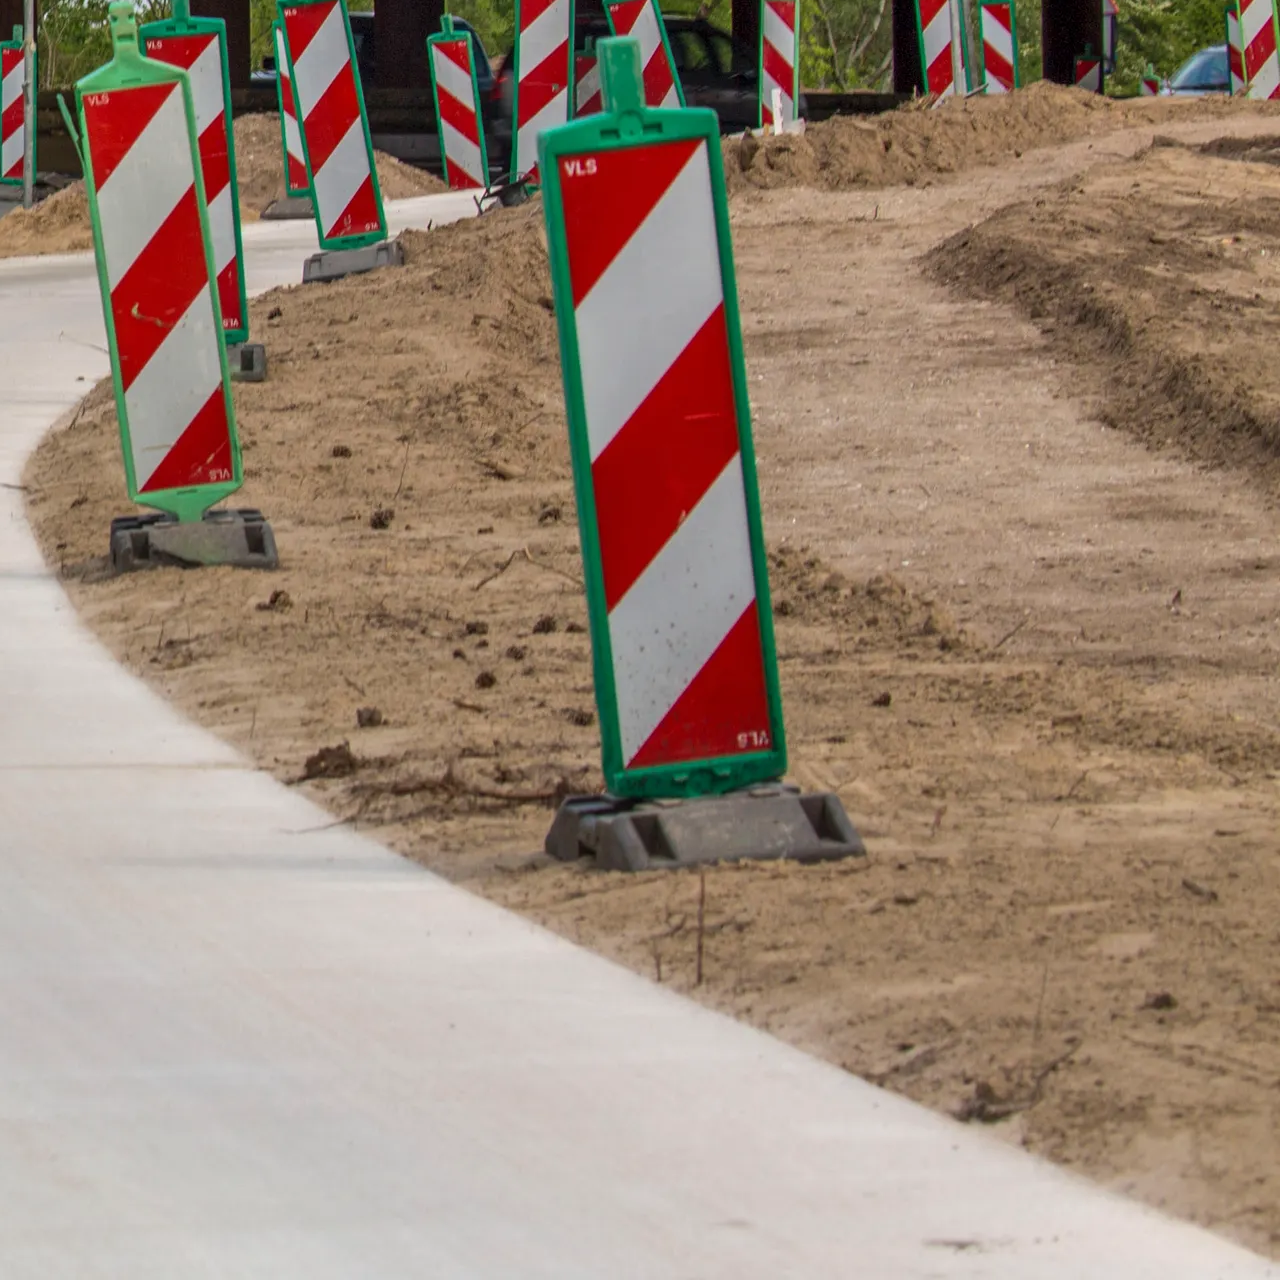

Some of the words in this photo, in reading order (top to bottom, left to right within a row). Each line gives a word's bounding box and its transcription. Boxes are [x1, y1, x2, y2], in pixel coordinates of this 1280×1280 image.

[87, 93, 110, 107] VLS
[564, 159, 598, 177] VLS
[737, 730, 770, 749] VLS
